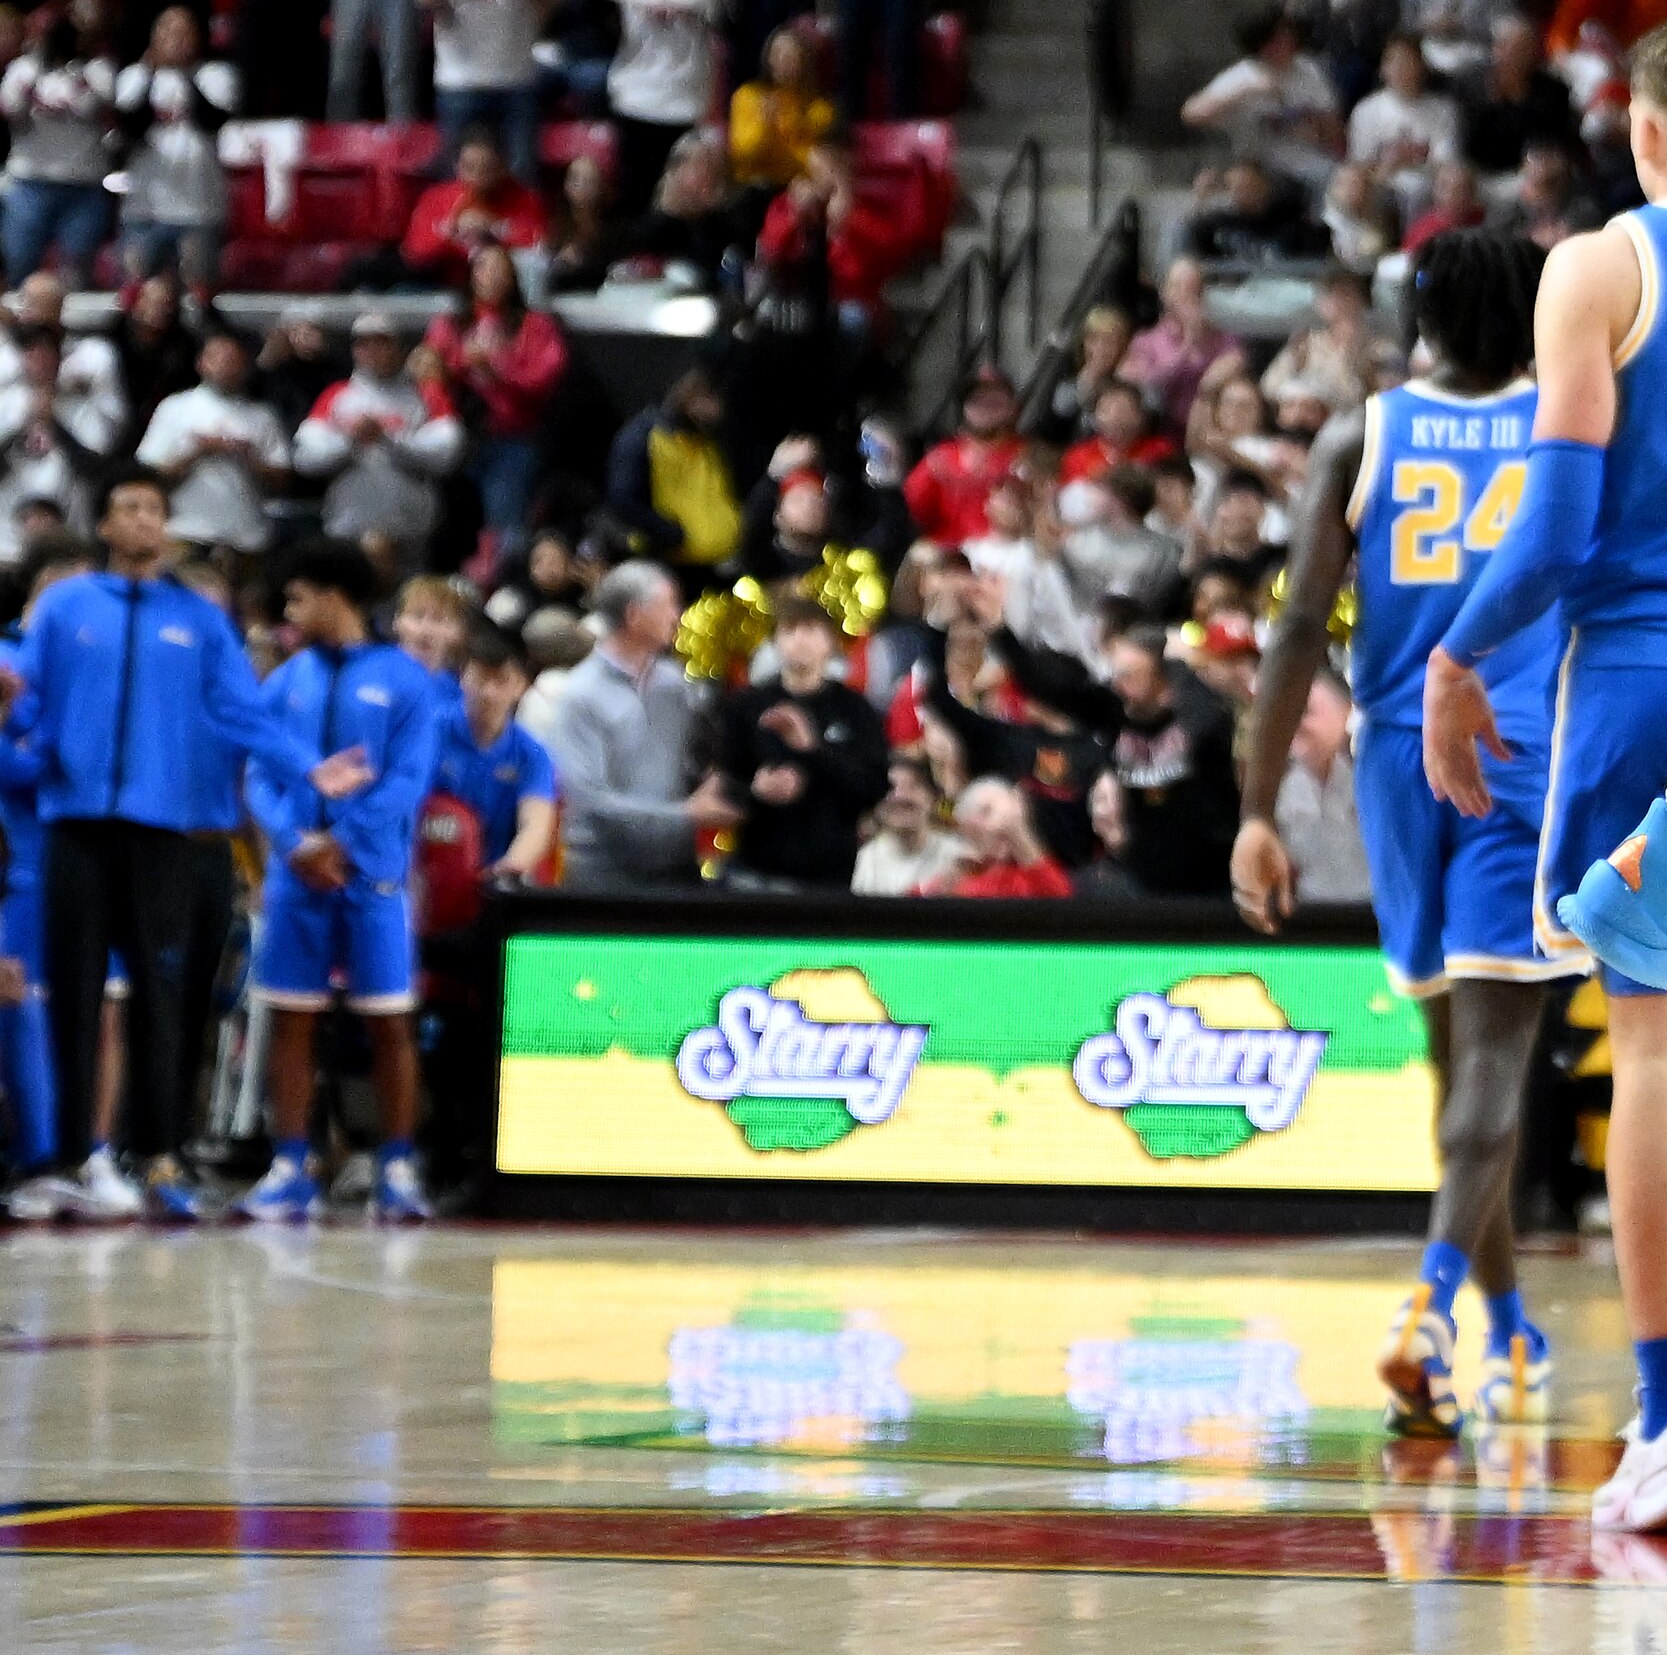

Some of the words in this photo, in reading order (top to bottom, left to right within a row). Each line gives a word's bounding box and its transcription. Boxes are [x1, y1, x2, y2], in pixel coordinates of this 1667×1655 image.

[1411, 416, 1482, 449] KYLE
[1489, 415, 1520, 449] III
[676, 985, 931, 1124] Starry
[1073, 992, 1331, 1131] Starry
